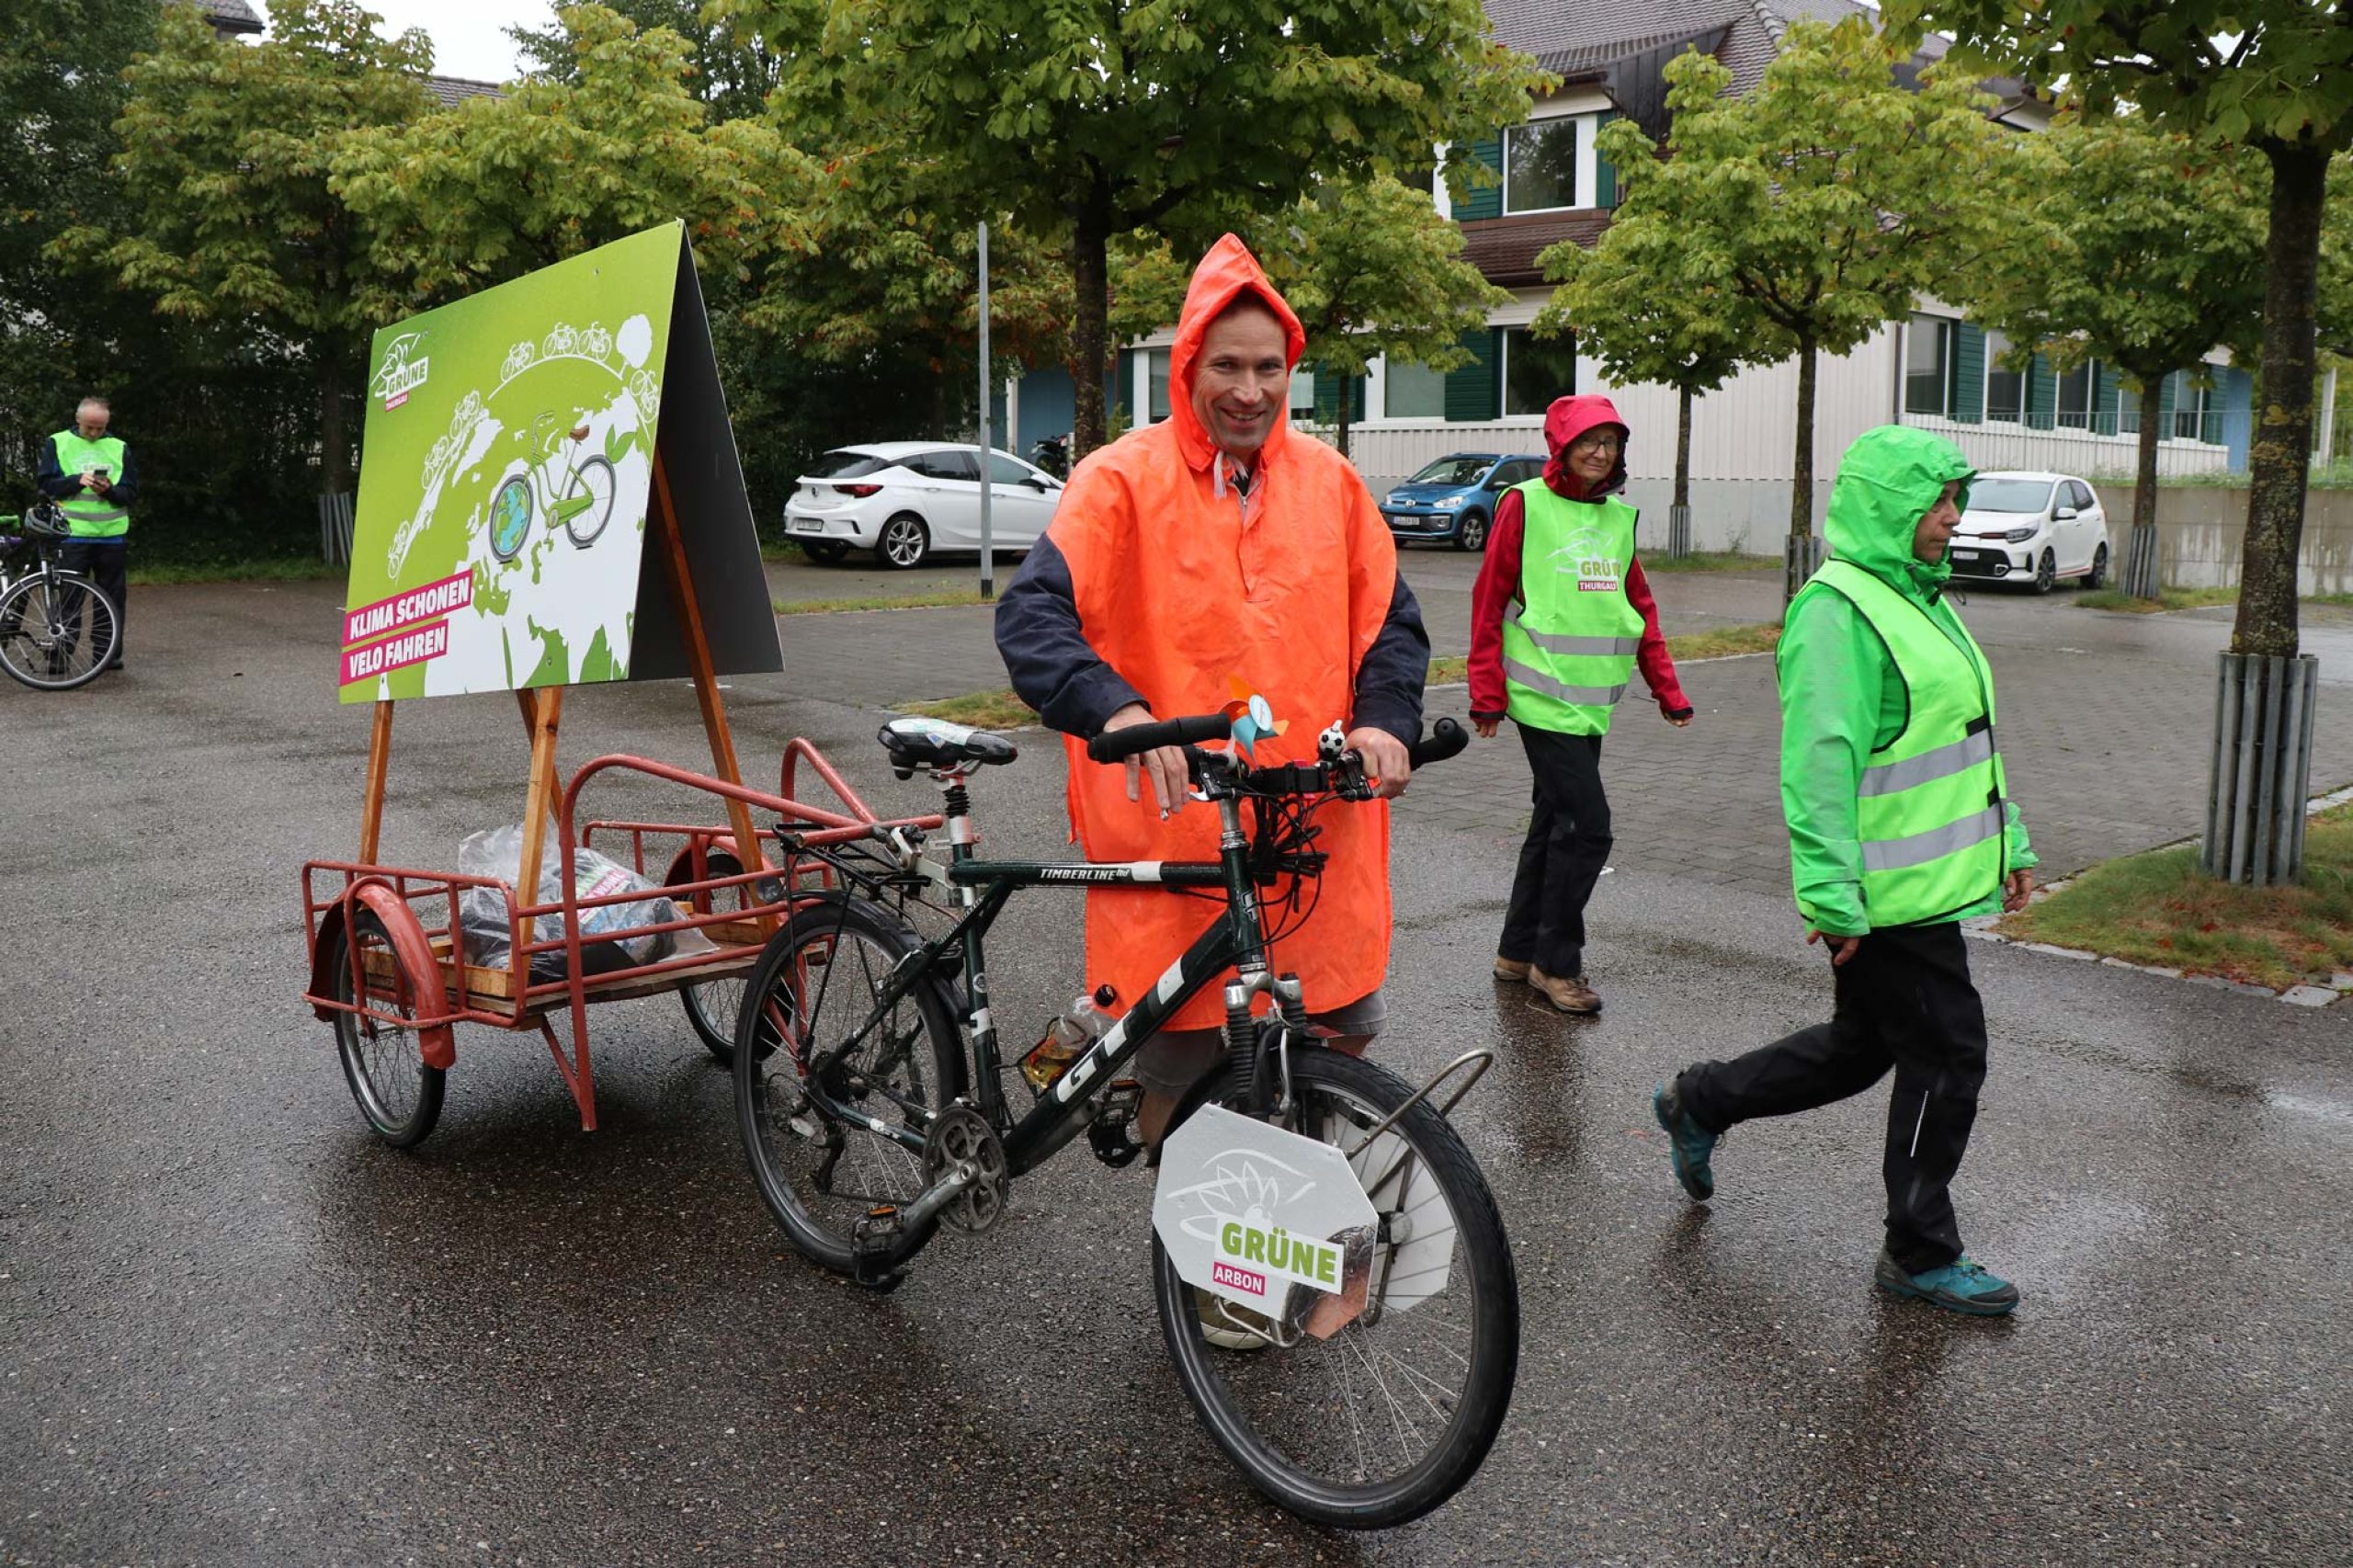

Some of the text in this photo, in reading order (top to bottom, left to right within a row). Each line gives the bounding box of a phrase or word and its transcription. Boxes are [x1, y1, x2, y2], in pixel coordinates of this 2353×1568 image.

[349, 576, 471, 641] KLIMA SCHONEN
[349, 626, 446, 678] VELO FAHREN
[1040, 868, 1116, 881] TIMBERLINE
[1214, 1266, 1262, 1292] ARBON
[1222, 1221, 1337, 1285] GRÜNE
